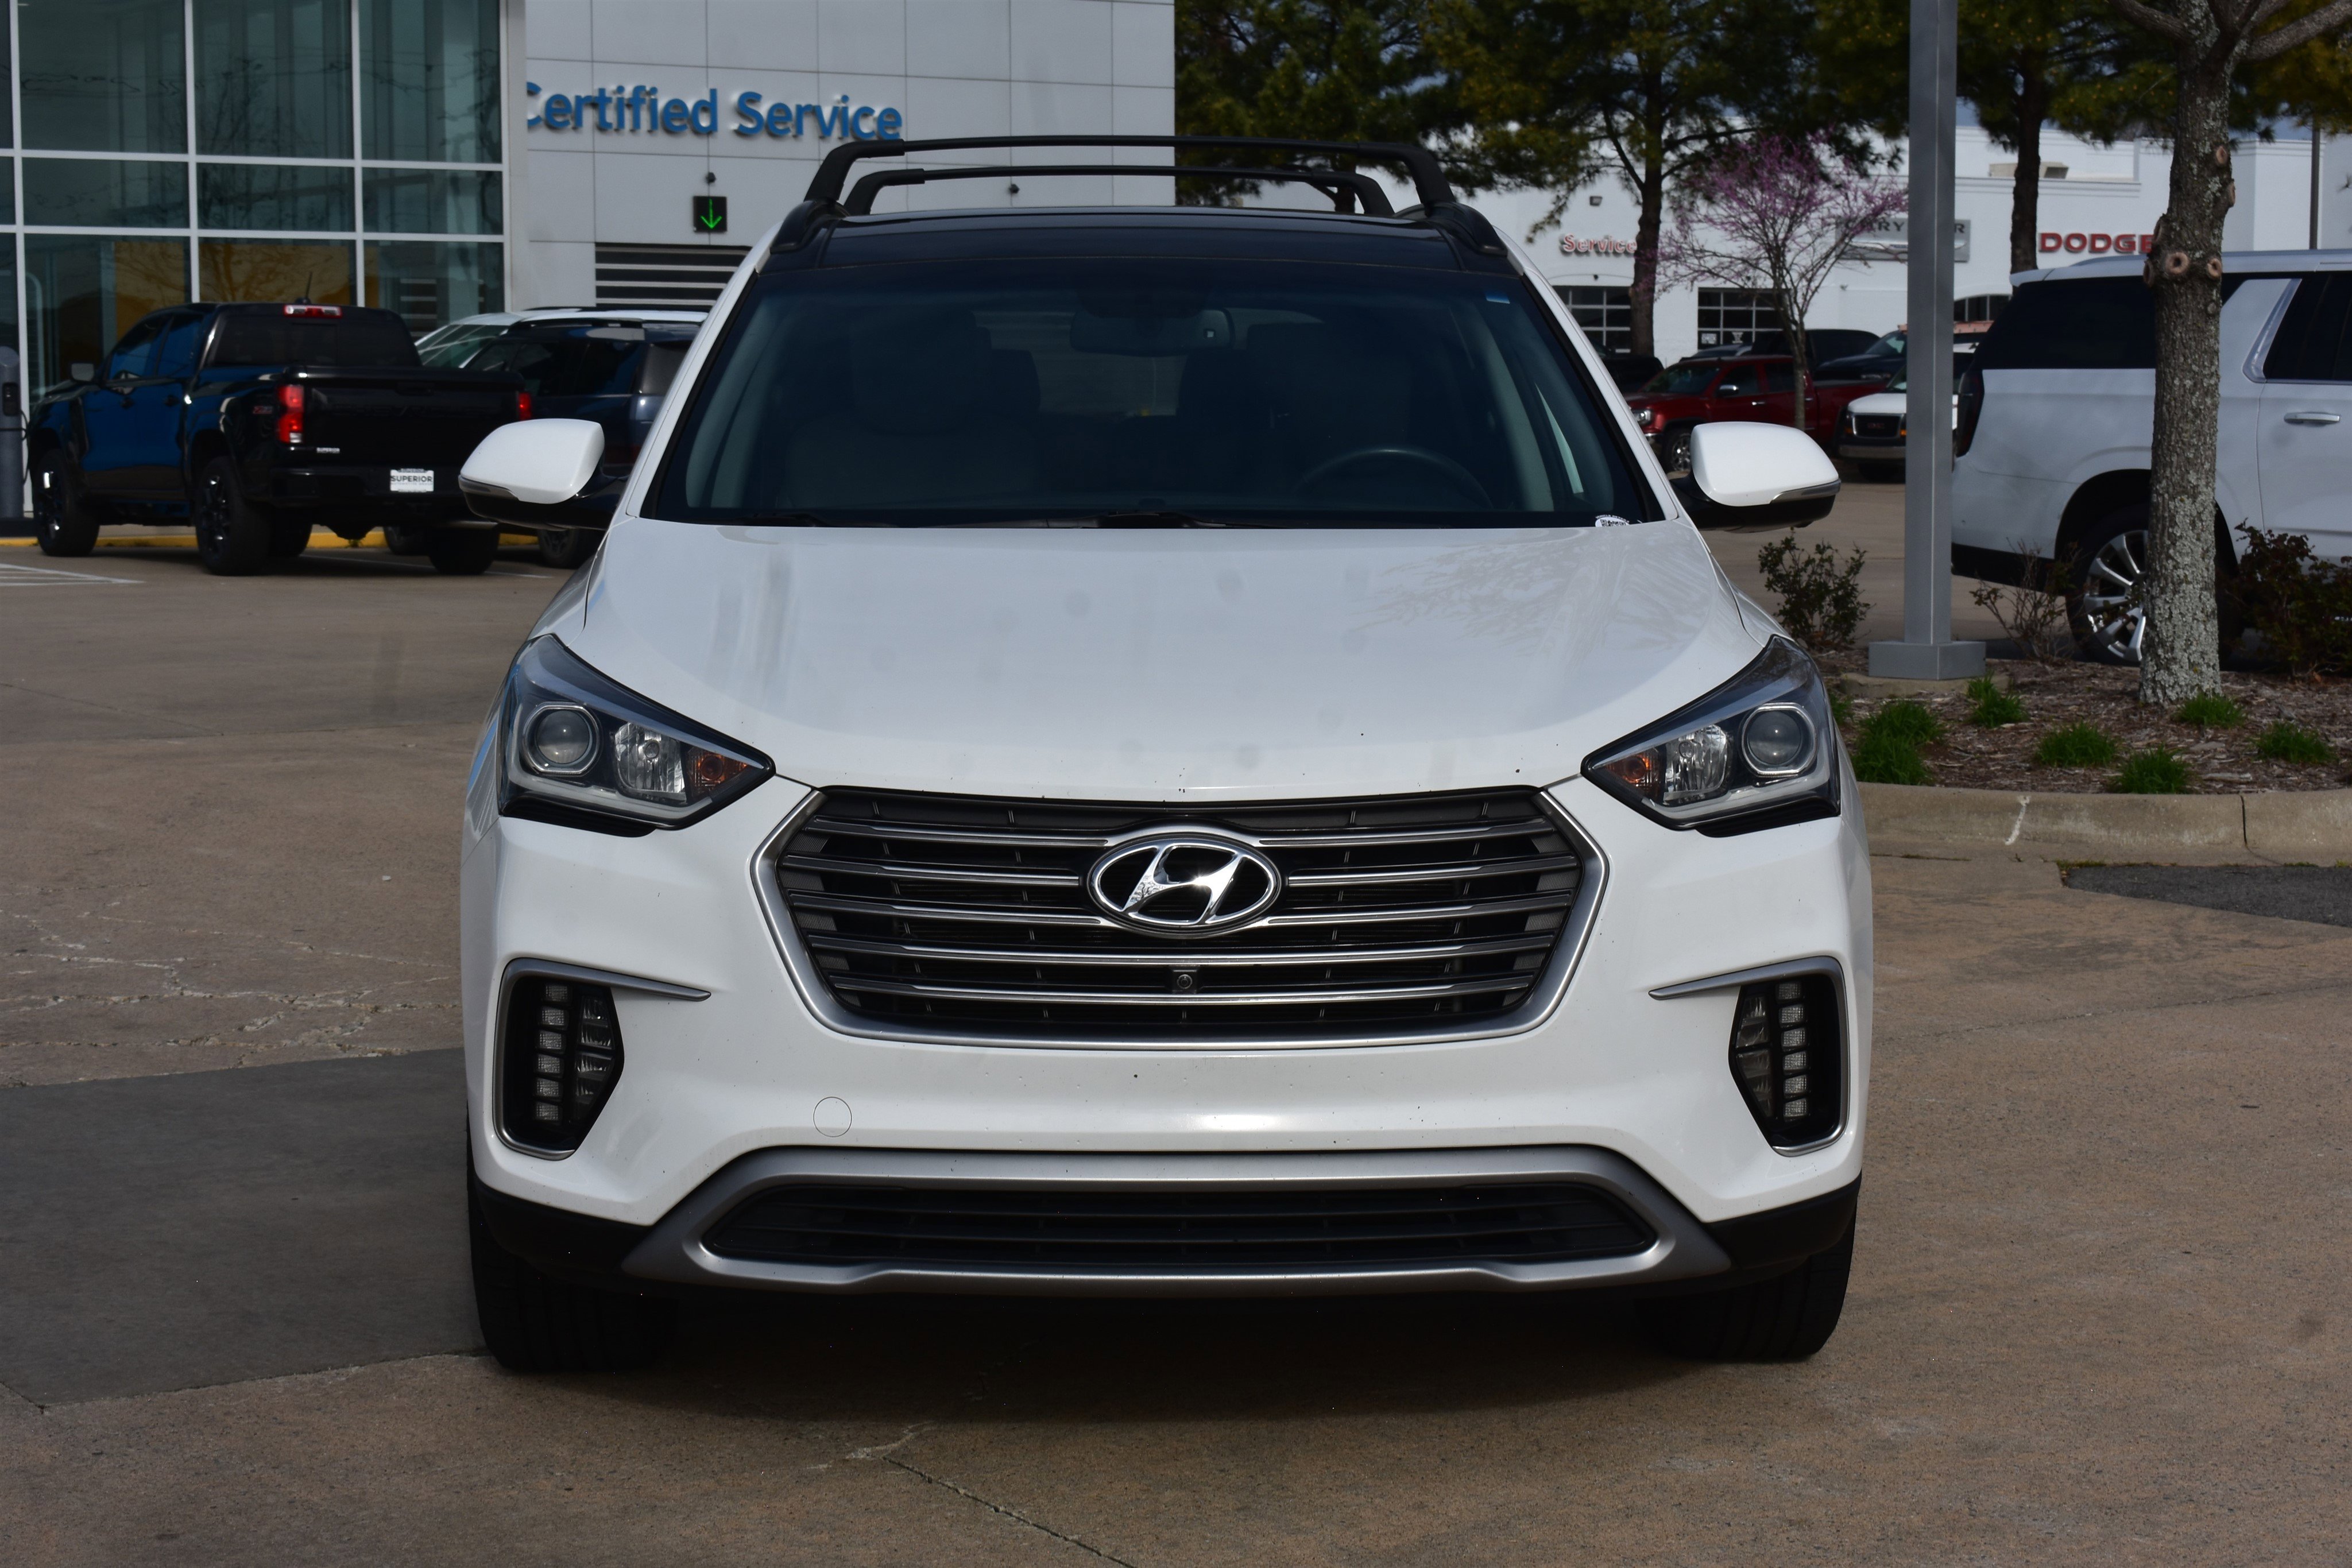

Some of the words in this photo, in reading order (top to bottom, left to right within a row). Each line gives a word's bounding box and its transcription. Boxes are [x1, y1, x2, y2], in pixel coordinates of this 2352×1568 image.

[737, 91, 903, 140] Service
[1563, 234, 1637, 253] Service
[2040, 233, 2154, 253] DODGE
